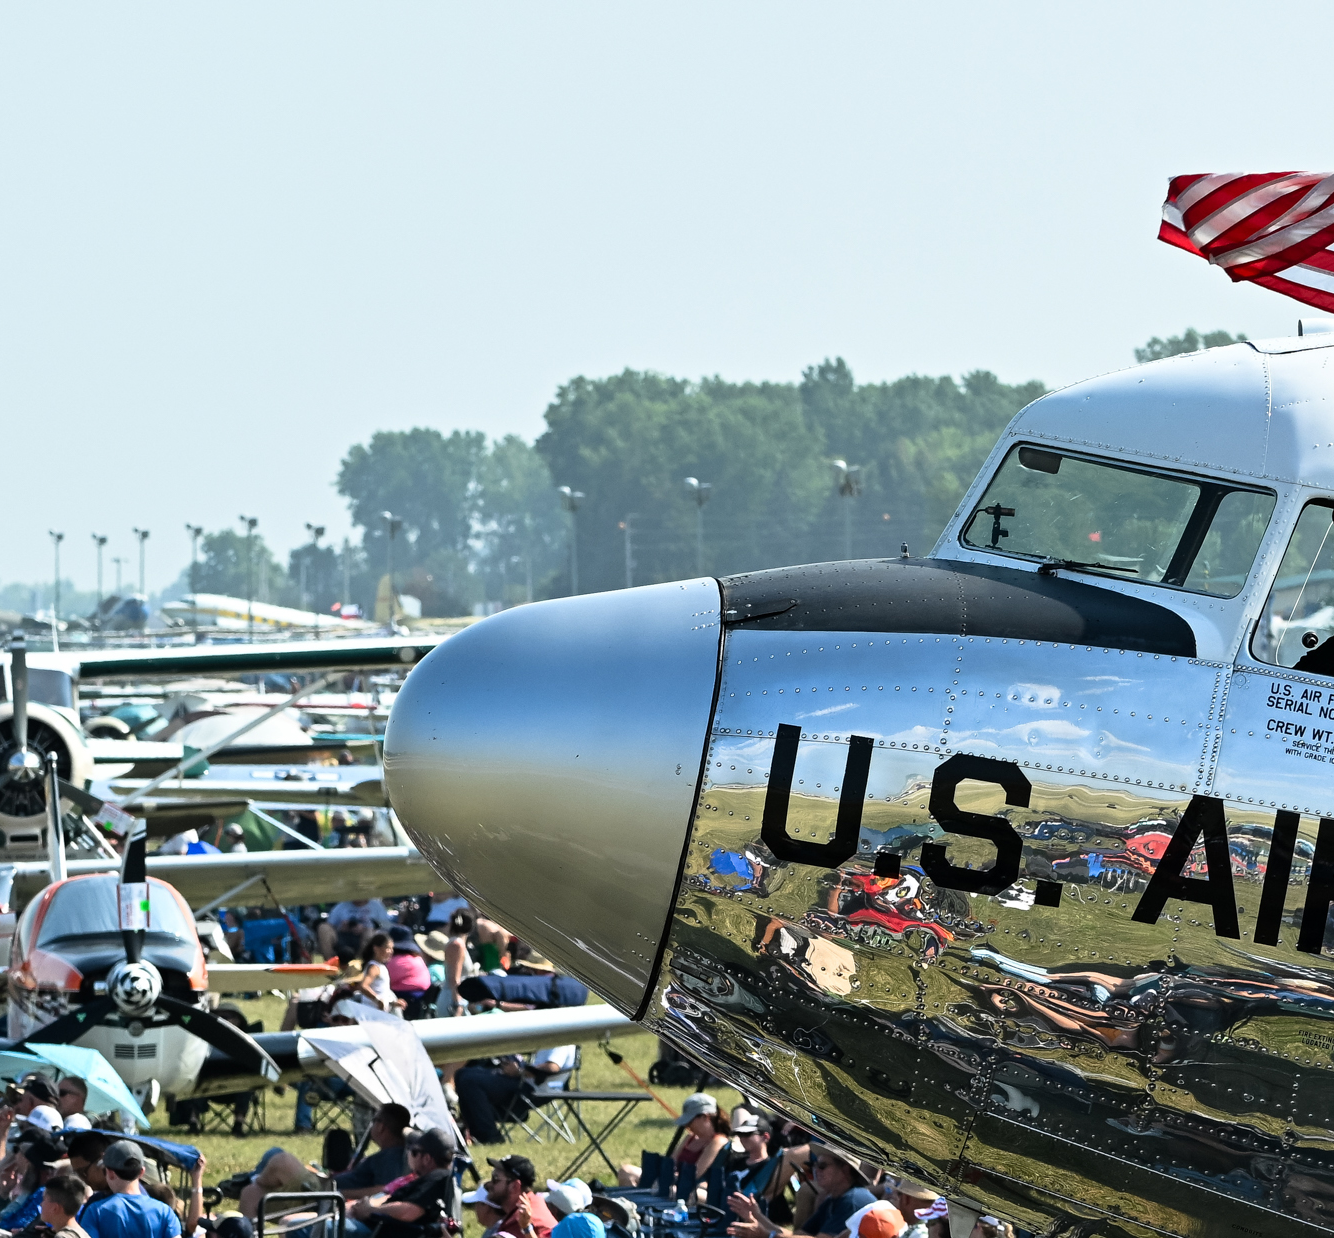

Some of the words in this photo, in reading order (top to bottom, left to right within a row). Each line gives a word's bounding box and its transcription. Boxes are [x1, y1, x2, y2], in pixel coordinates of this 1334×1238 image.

[1270, 683, 1294, 698] U.S.
[1300, 689, 1323, 703] AIR
[1267, 695, 1313, 716] SERIAL
[1267, 719, 1306, 737] CREW
[1312, 728, 1334, 744] WT.
[1292, 740, 1321, 753] SERVICE
[1285, 748, 1301, 758] WITH
[1304, 752, 1326, 763] GRADE
[761, 724, 1062, 908] U.S.
[1298, 1030, 1312, 1039] FIRE
[1302, 1038, 1329, 1050] LOCATED
